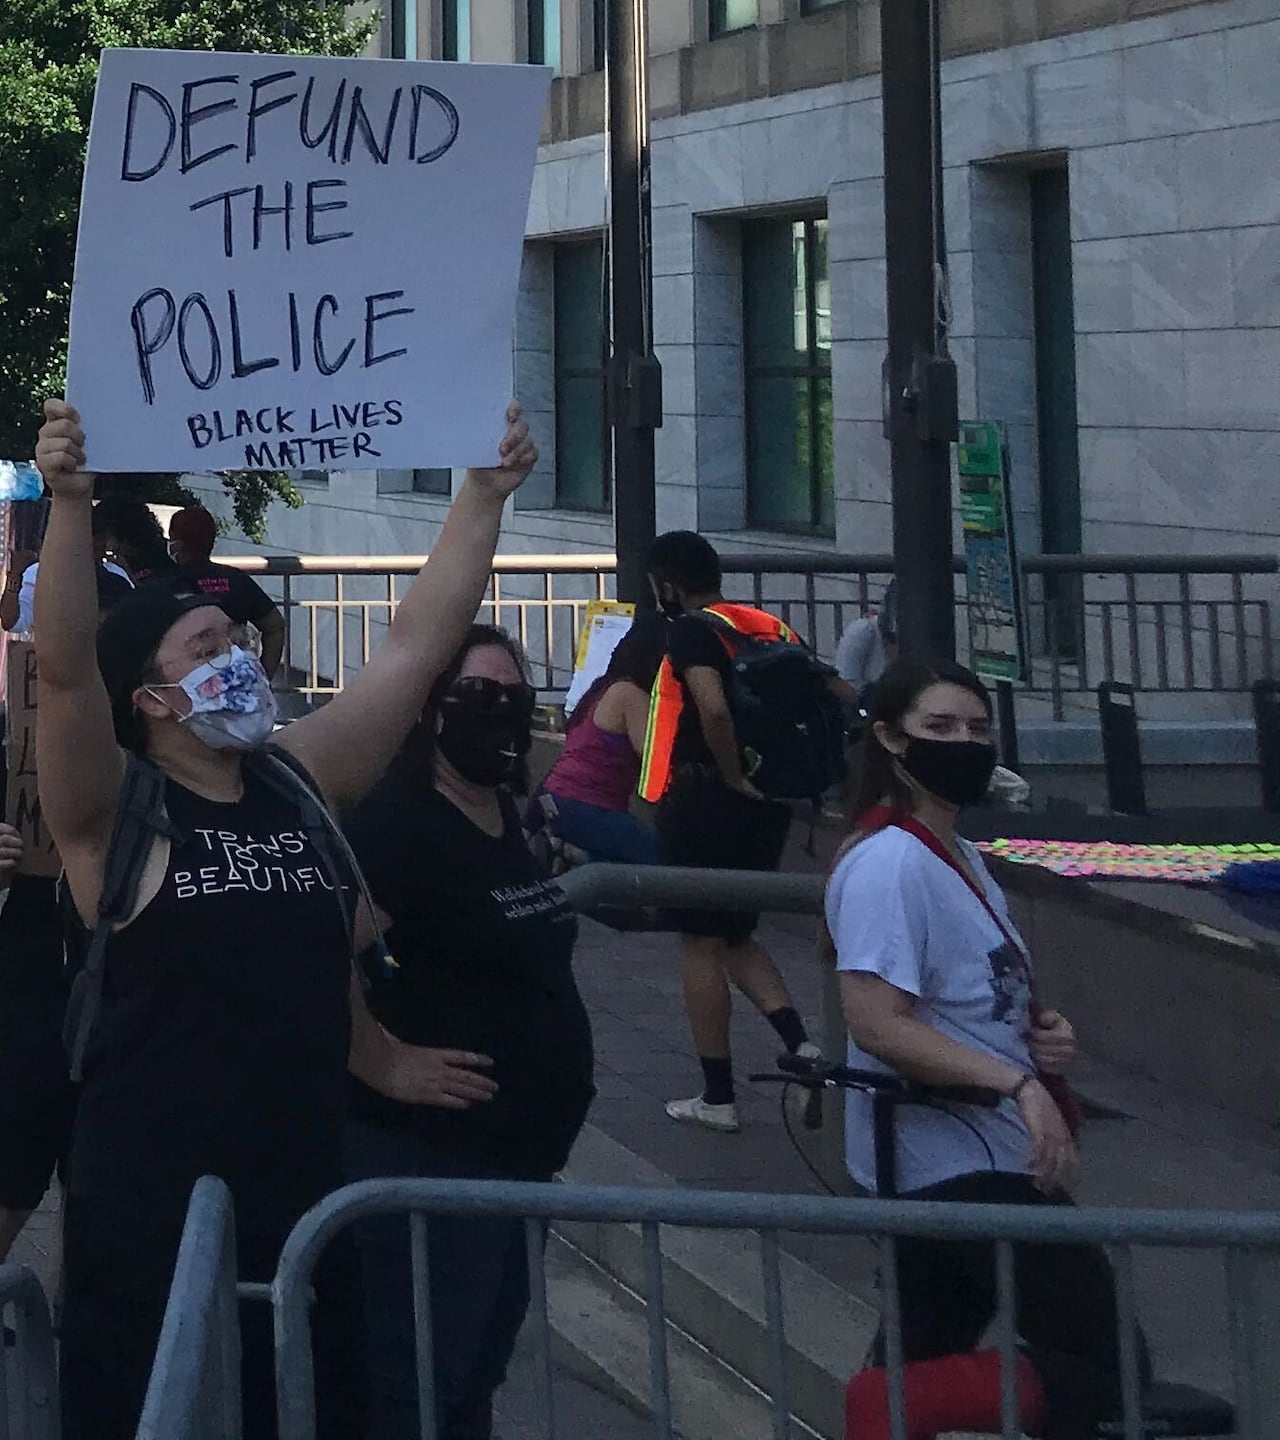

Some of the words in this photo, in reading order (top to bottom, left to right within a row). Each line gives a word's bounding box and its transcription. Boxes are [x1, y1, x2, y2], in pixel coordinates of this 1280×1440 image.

[121, 70, 460, 181] DEFUND
[189, 179, 355, 258] THE
[130, 287, 416, 406] POLICE
[187, 406, 296, 449] BLACK
[309, 399, 403, 433] LIVES
[244, 432, 382, 469] MATTER
